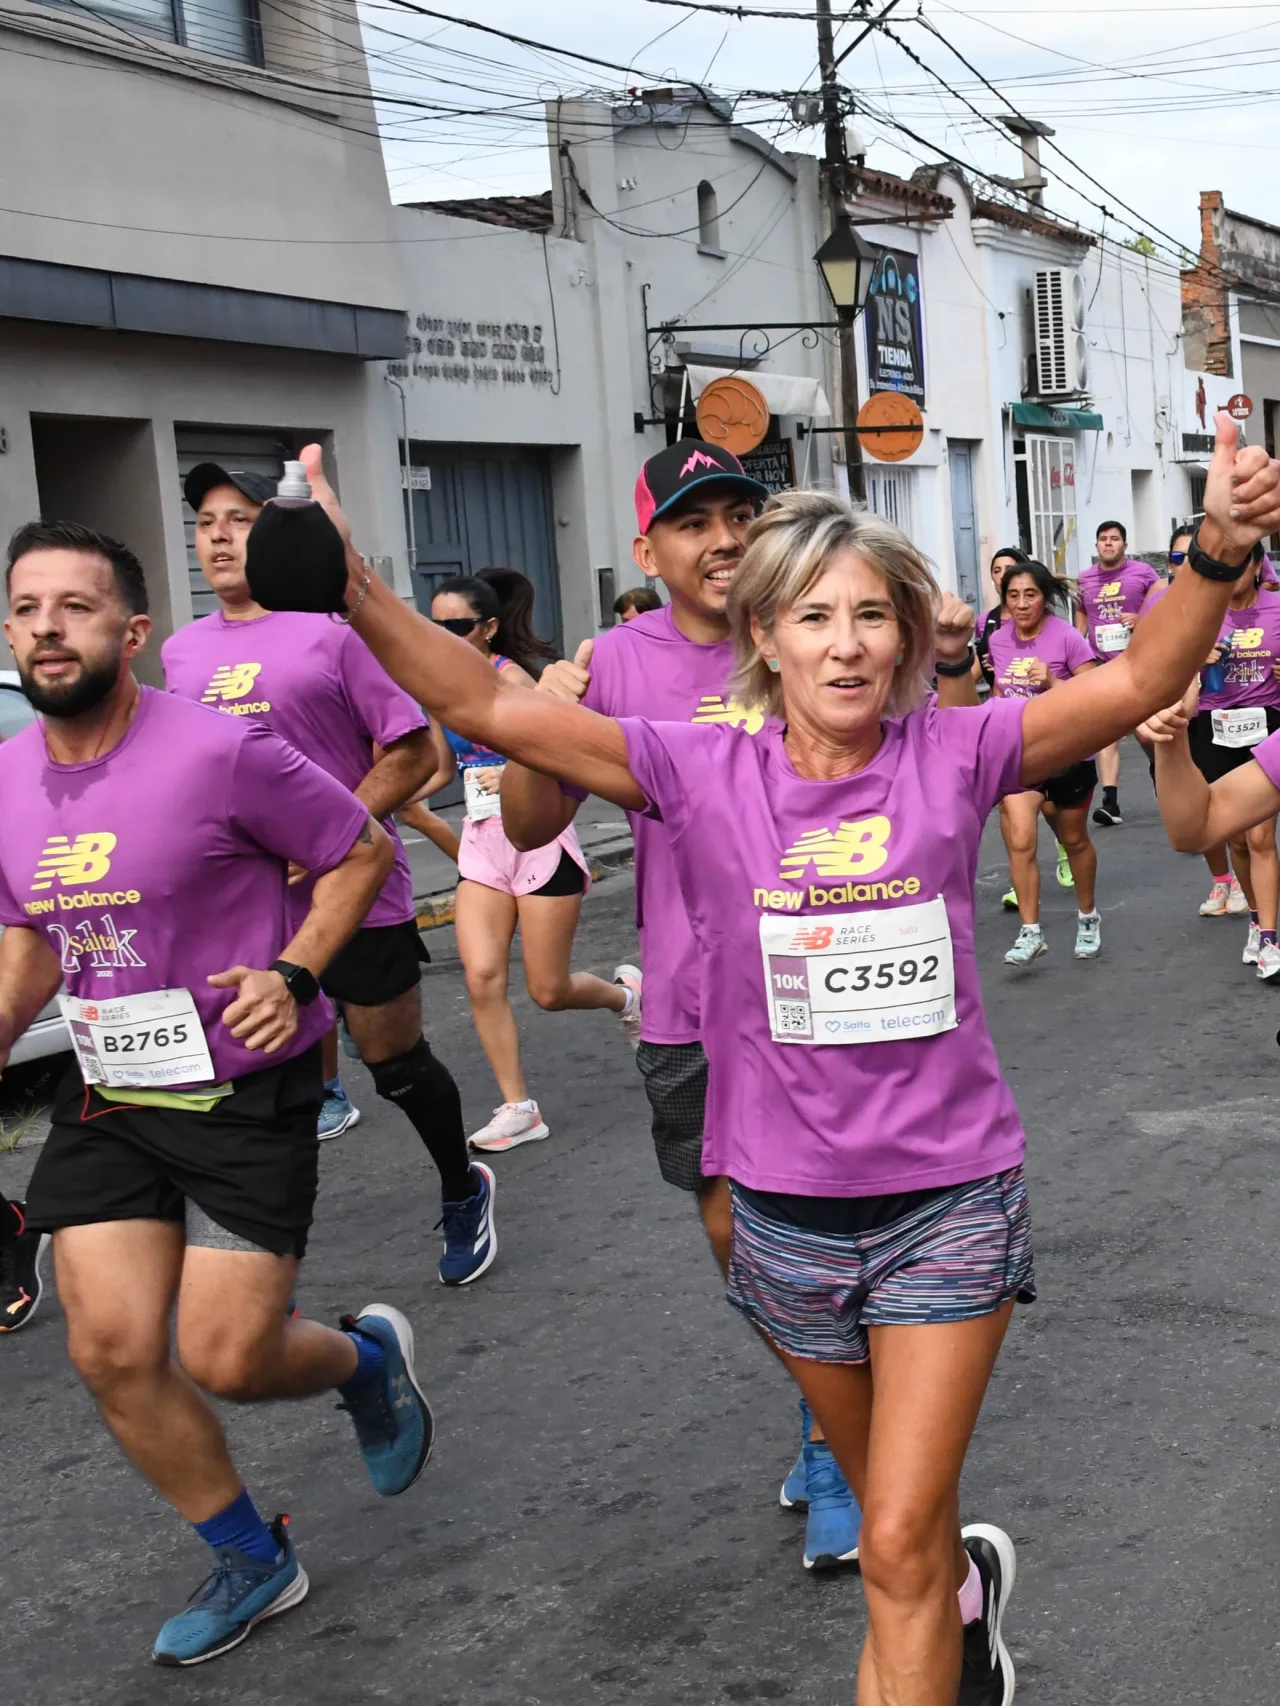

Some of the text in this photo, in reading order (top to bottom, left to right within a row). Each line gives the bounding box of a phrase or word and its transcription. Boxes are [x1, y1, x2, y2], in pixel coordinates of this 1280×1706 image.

[875, 296, 913, 345] NS
[877, 345, 912, 367] TIENDA
[742, 457, 780, 469] OFERTA
[764, 468, 786, 481] HOY
[1236, 650, 1271, 658] balance
[1228, 722, 1260, 733] C3521
[753, 876, 921, 910] new balance
[24, 889, 141, 915] new balance
[840, 924, 872, 936] RACE
[46, 913, 147, 973] 21k
[69, 931, 118, 956] Salta
[836, 934, 876, 946] SERIES
[773, 973, 808, 991] 10K
[824, 955, 939, 993] C3592
[101, 1013, 131, 1021] SERIES
[102, 1006, 126, 1014] RACE
[843, 1020, 871, 1030] Salta
[880, 1009, 945, 1030] telecom
[103, 1024, 188, 1053] B2765
[150, 1063, 202, 1078] telecom
